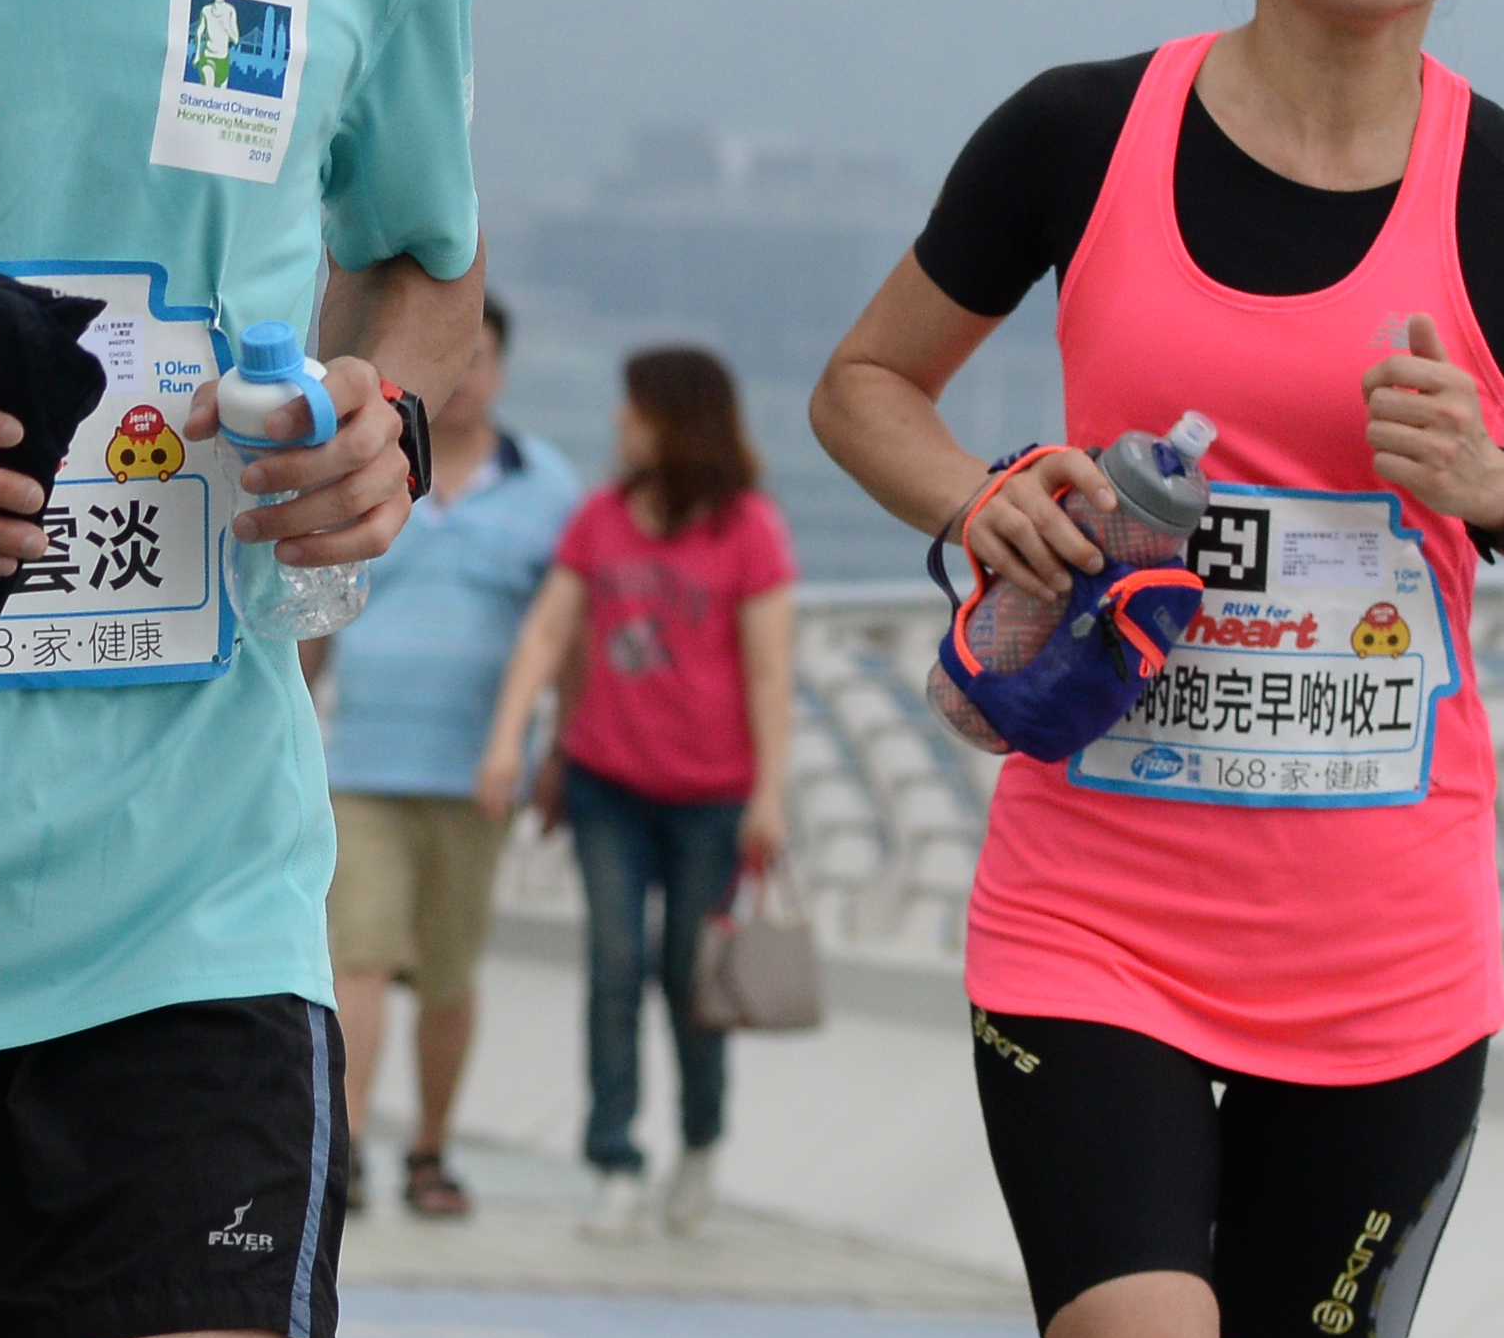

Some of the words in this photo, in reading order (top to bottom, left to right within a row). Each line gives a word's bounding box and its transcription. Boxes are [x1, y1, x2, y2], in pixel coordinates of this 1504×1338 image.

[179, 93, 230, 112] Standard
[231, 101, 282, 121] Chartered
[176, 108, 206, 125] Hong
[207, 112, 233, 129] Kong
[233, 117, 278, 135] Marathon
[248, 149, 272, 163] 2019
[154, 360, 202, 376] 10km
[159, 379, 195, 393] Run
[1222, 602, 1261, 618] RUN
[1266, 606, 1292, 619] for
[1184, 608, 1318, 650] heart
[208, 1231, 274, 1246] FLYER
